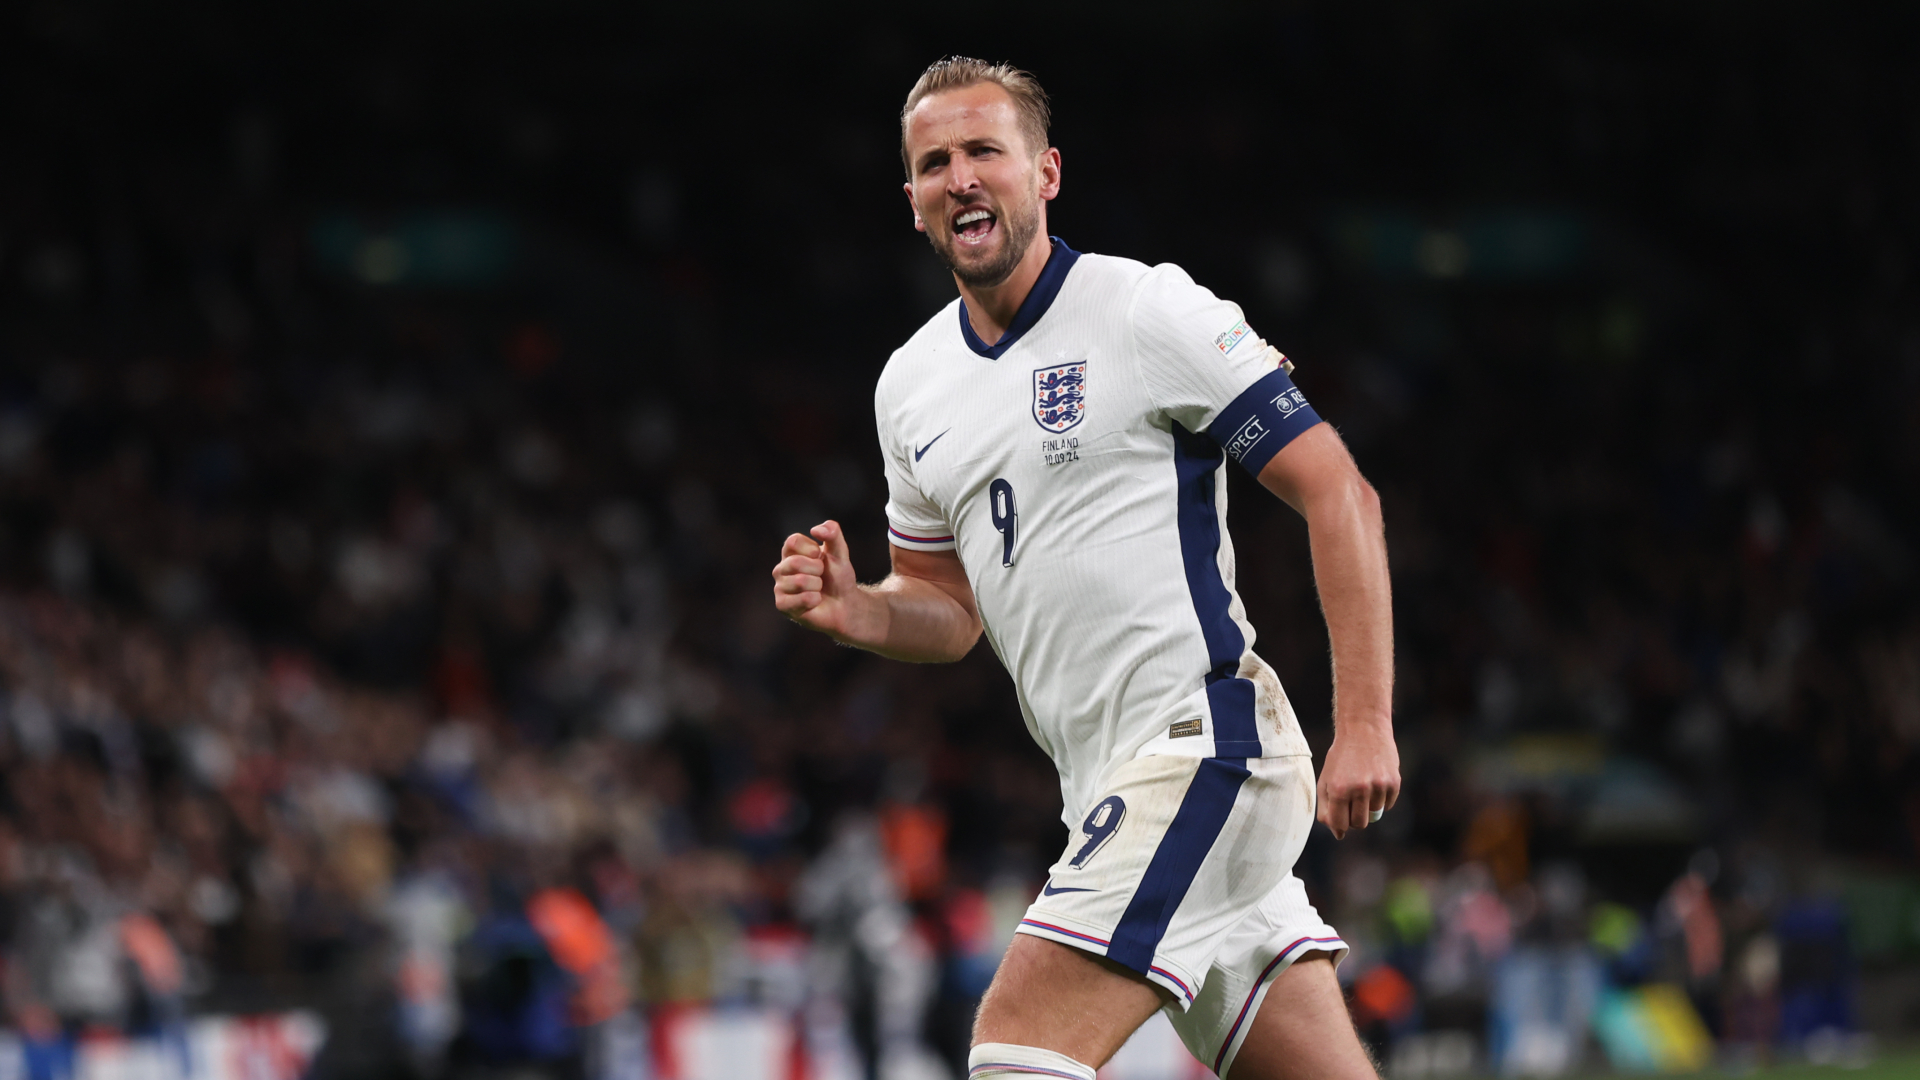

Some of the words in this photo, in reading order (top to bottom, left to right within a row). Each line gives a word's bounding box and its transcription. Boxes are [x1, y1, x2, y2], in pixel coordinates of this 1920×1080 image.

[1213, 331, 1228, 345] UEFA
[1042, 437, 1079, 452] FINLAND
[1228, 418, 1264, 459] SPECT
[1044, 450, 1079, 466] 10.09.24
[990, 477, 1019, 568] 9
[1068, 795, 1127, 870] 9
